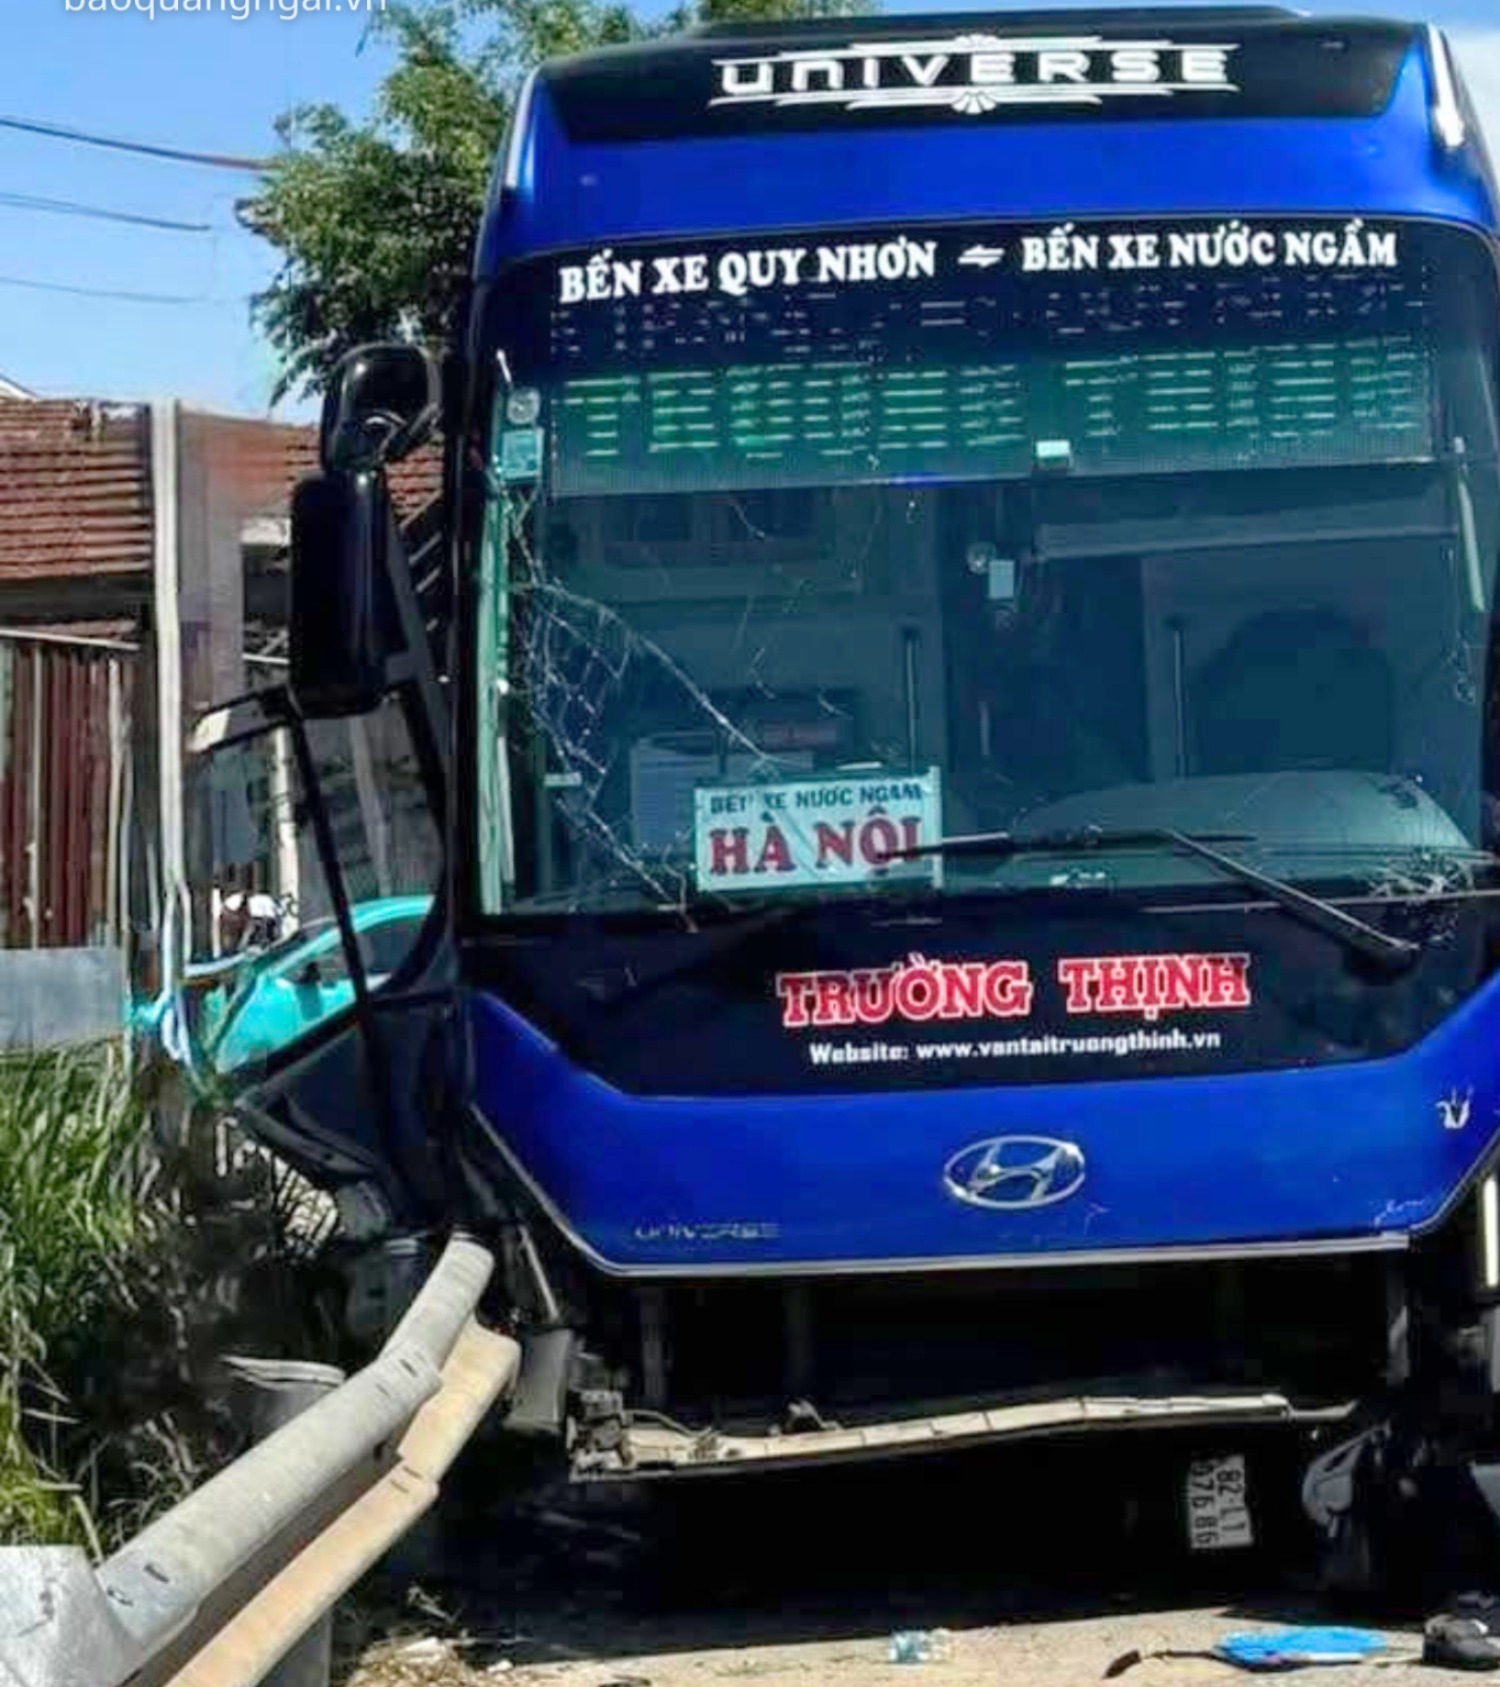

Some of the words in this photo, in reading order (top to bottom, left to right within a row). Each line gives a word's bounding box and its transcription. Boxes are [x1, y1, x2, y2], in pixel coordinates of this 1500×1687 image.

[721, 49, 1230, 96] UNIVERSE
[558, 248, 642, 304] BẾN
[651, 253, 710, 295] XE
[717, 247, 806, 297] QUY
[815, 235, 938, 283] NHƠN
[1021, 222, 1099, 272] BẾN
[1107, 233, 1161, 269] XE
[1168, 219, 1275, 267] NƯỚC
[1283, 217, 1398, 268] NGẦM
[709, 811, 797, 877] HÀ
[776, 952, 1033, 1027] TRƯỜNG
[1058, 953, 1252, 1021] THỊNH
[809, 1041, 910, 1065] Website:
